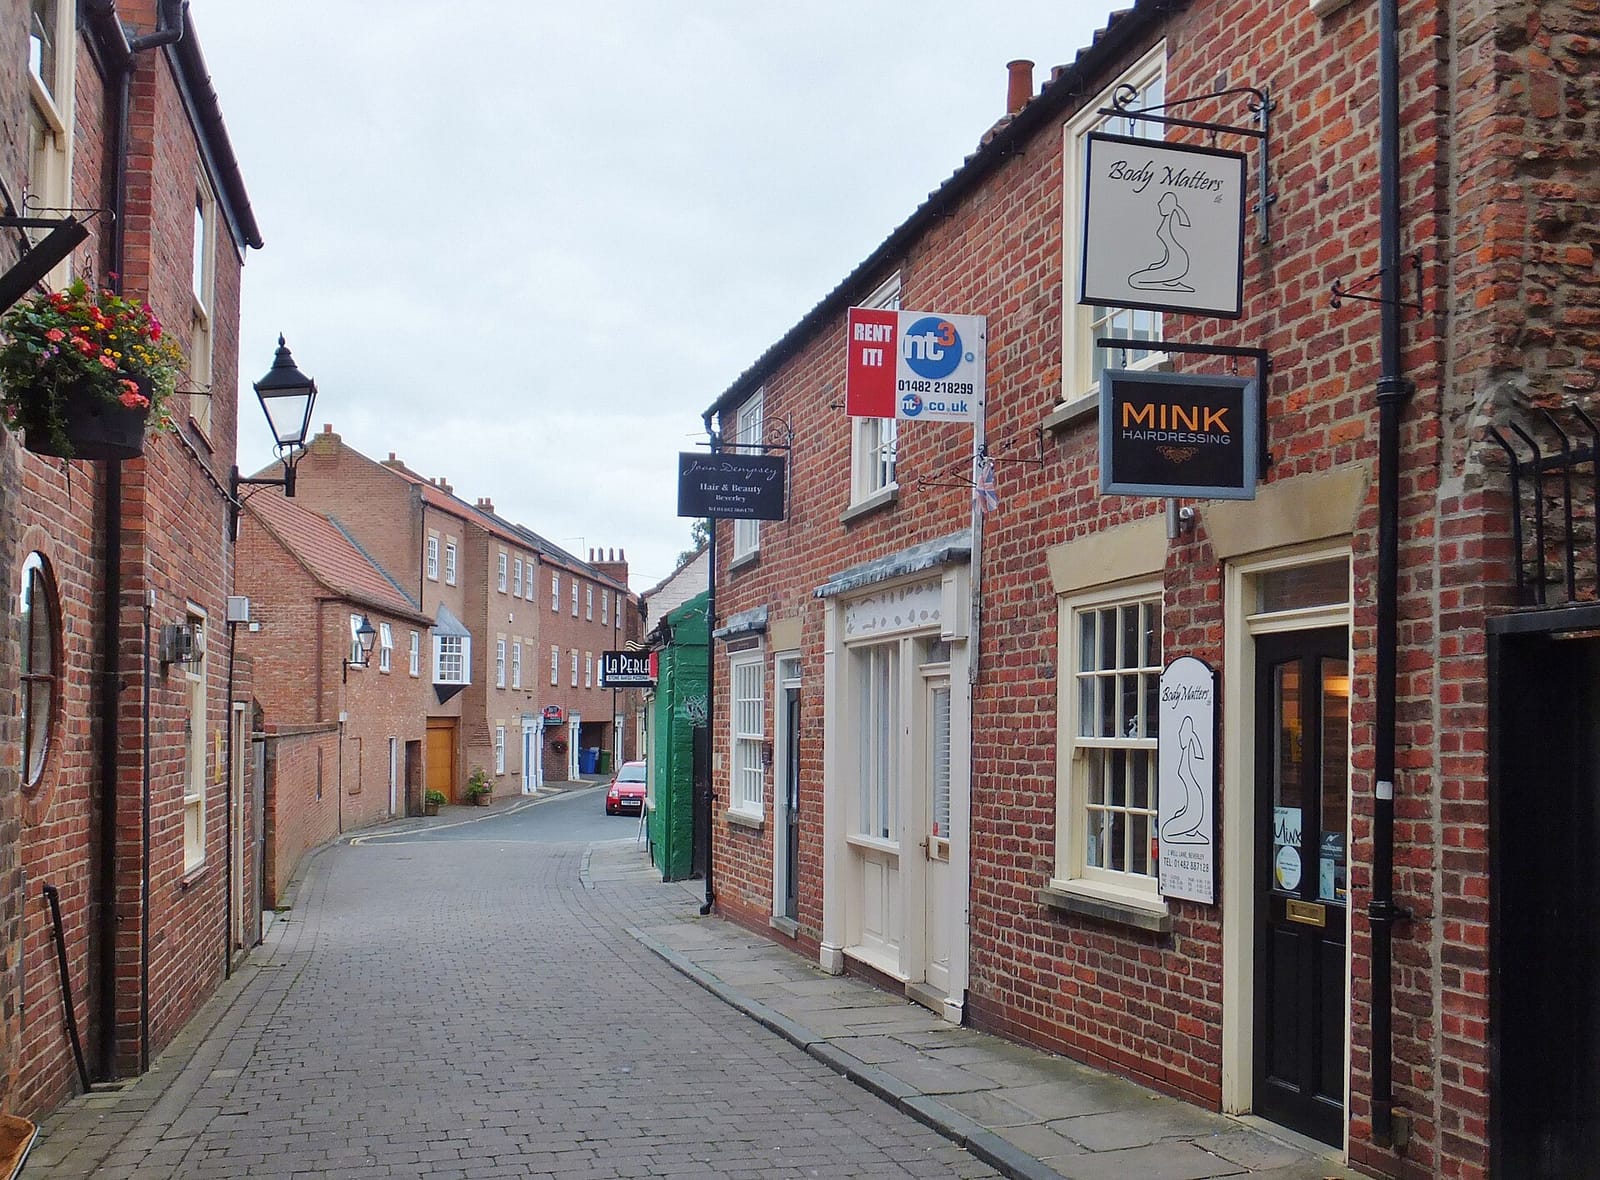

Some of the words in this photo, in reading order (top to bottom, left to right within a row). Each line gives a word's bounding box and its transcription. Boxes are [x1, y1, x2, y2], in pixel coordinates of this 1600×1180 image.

[1108, 160, 1154, 193] Body
[1160, 166, 1224, 191] Matters
[854, 322, 893, 343] RENT
[862, 347, 883, 367] IT!
[898, 379, 931, 394] 01482
[934, 381, 974, 395] 218299
[1122, 402, 1230, 433] MINK
[1122, 430, 1231, 445] HAIRDRESSING
[700, 483, 720, 491] Hair
[732, 484, 762, 494] Beauty
[715, 495, 745, 503] Beverley
[606, 654, 618, 673] LA
[1162, 683, 1181, 709] Body
[1181, 685, 1210, 701] Matters
[1174, 858, 1189, 870] 01482
